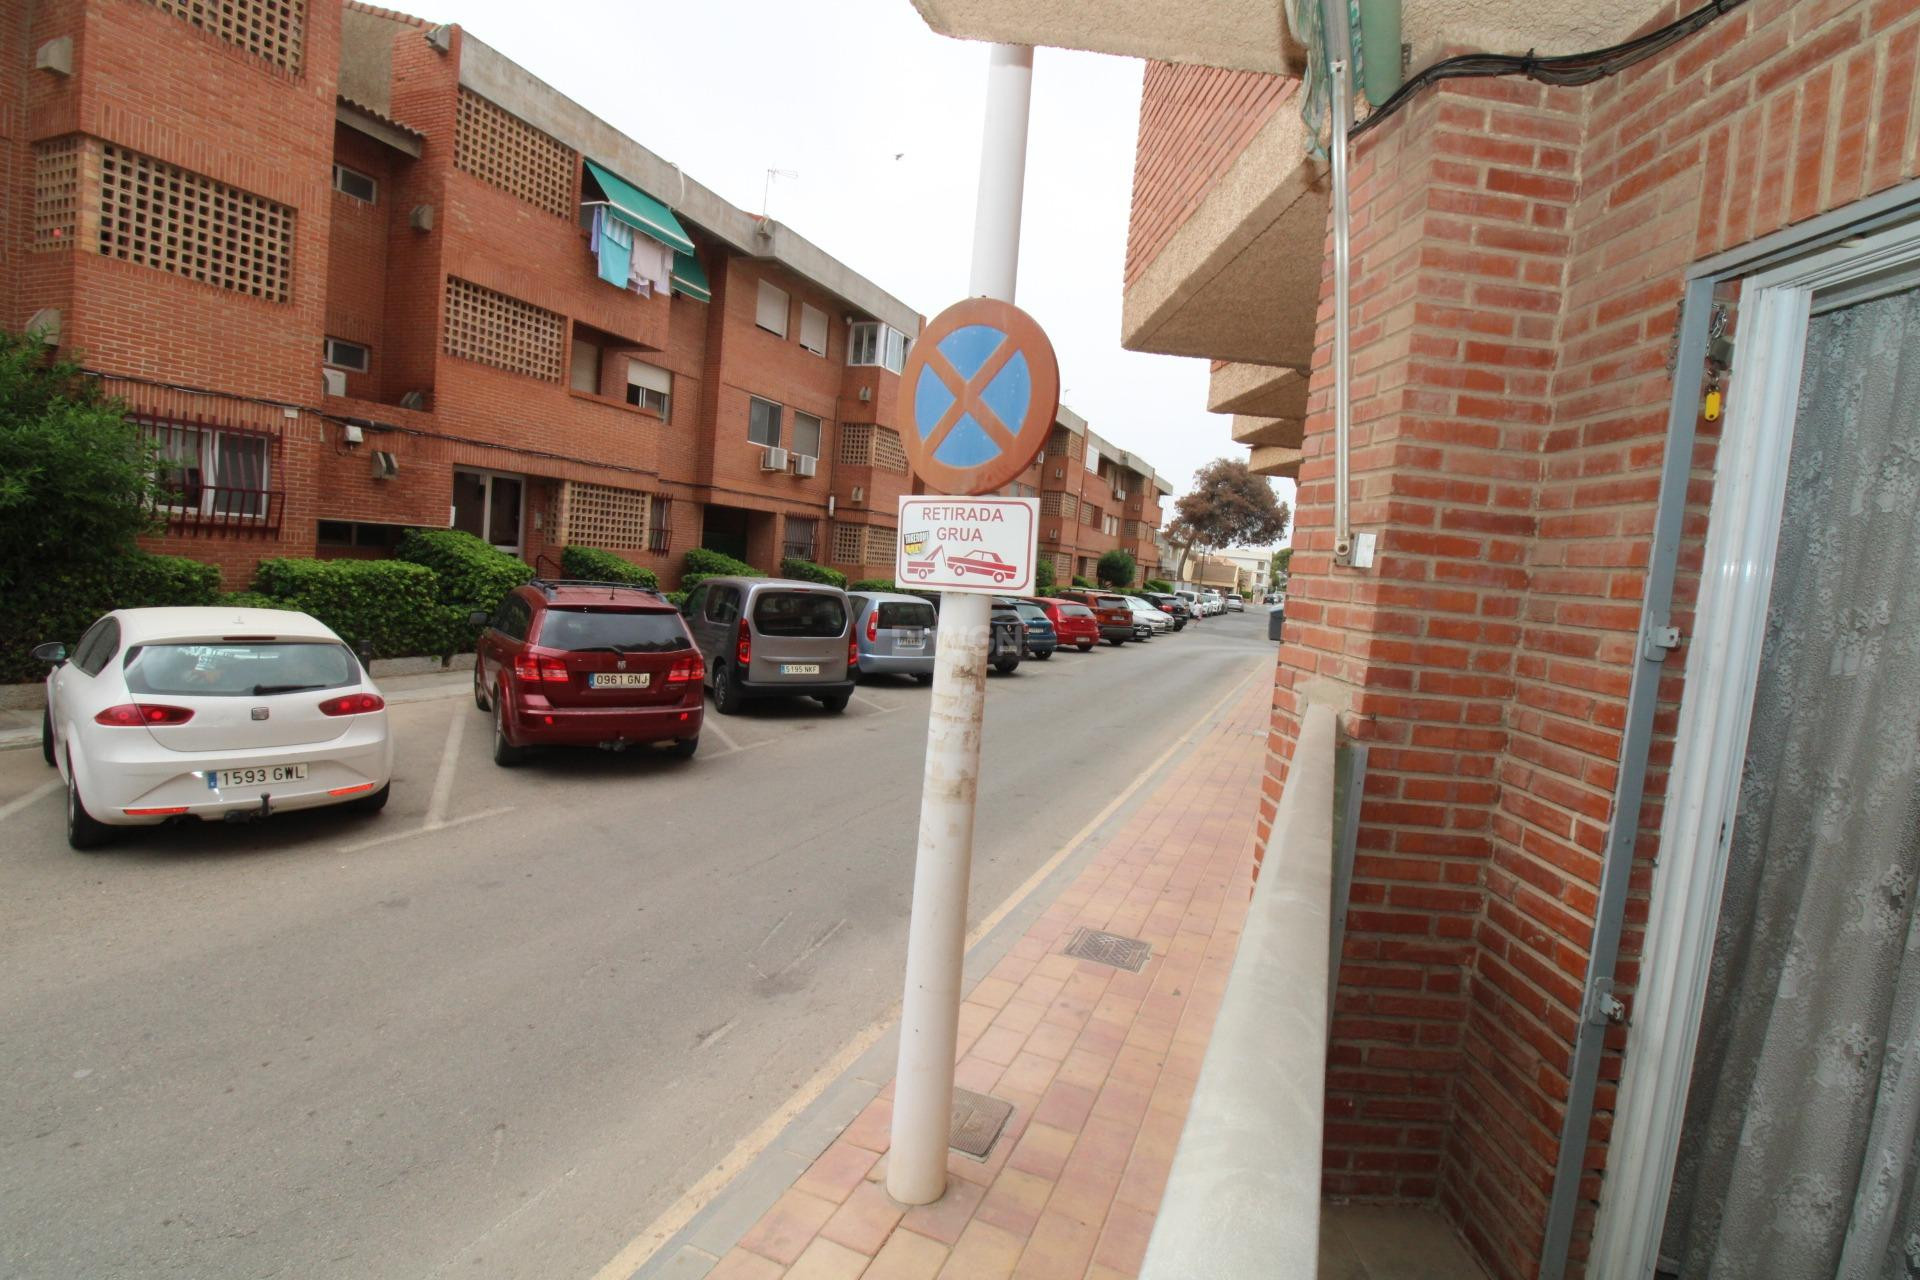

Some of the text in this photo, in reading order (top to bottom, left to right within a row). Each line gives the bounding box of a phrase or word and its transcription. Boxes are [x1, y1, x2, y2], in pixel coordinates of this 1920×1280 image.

[922, 507, 1005, 522] RETIRADA
[936, 527, 983, 542] GRUA
[596, 674, 649, 685] 0961 GNJ
[223, 766, 304, 785] 1593 GWL
